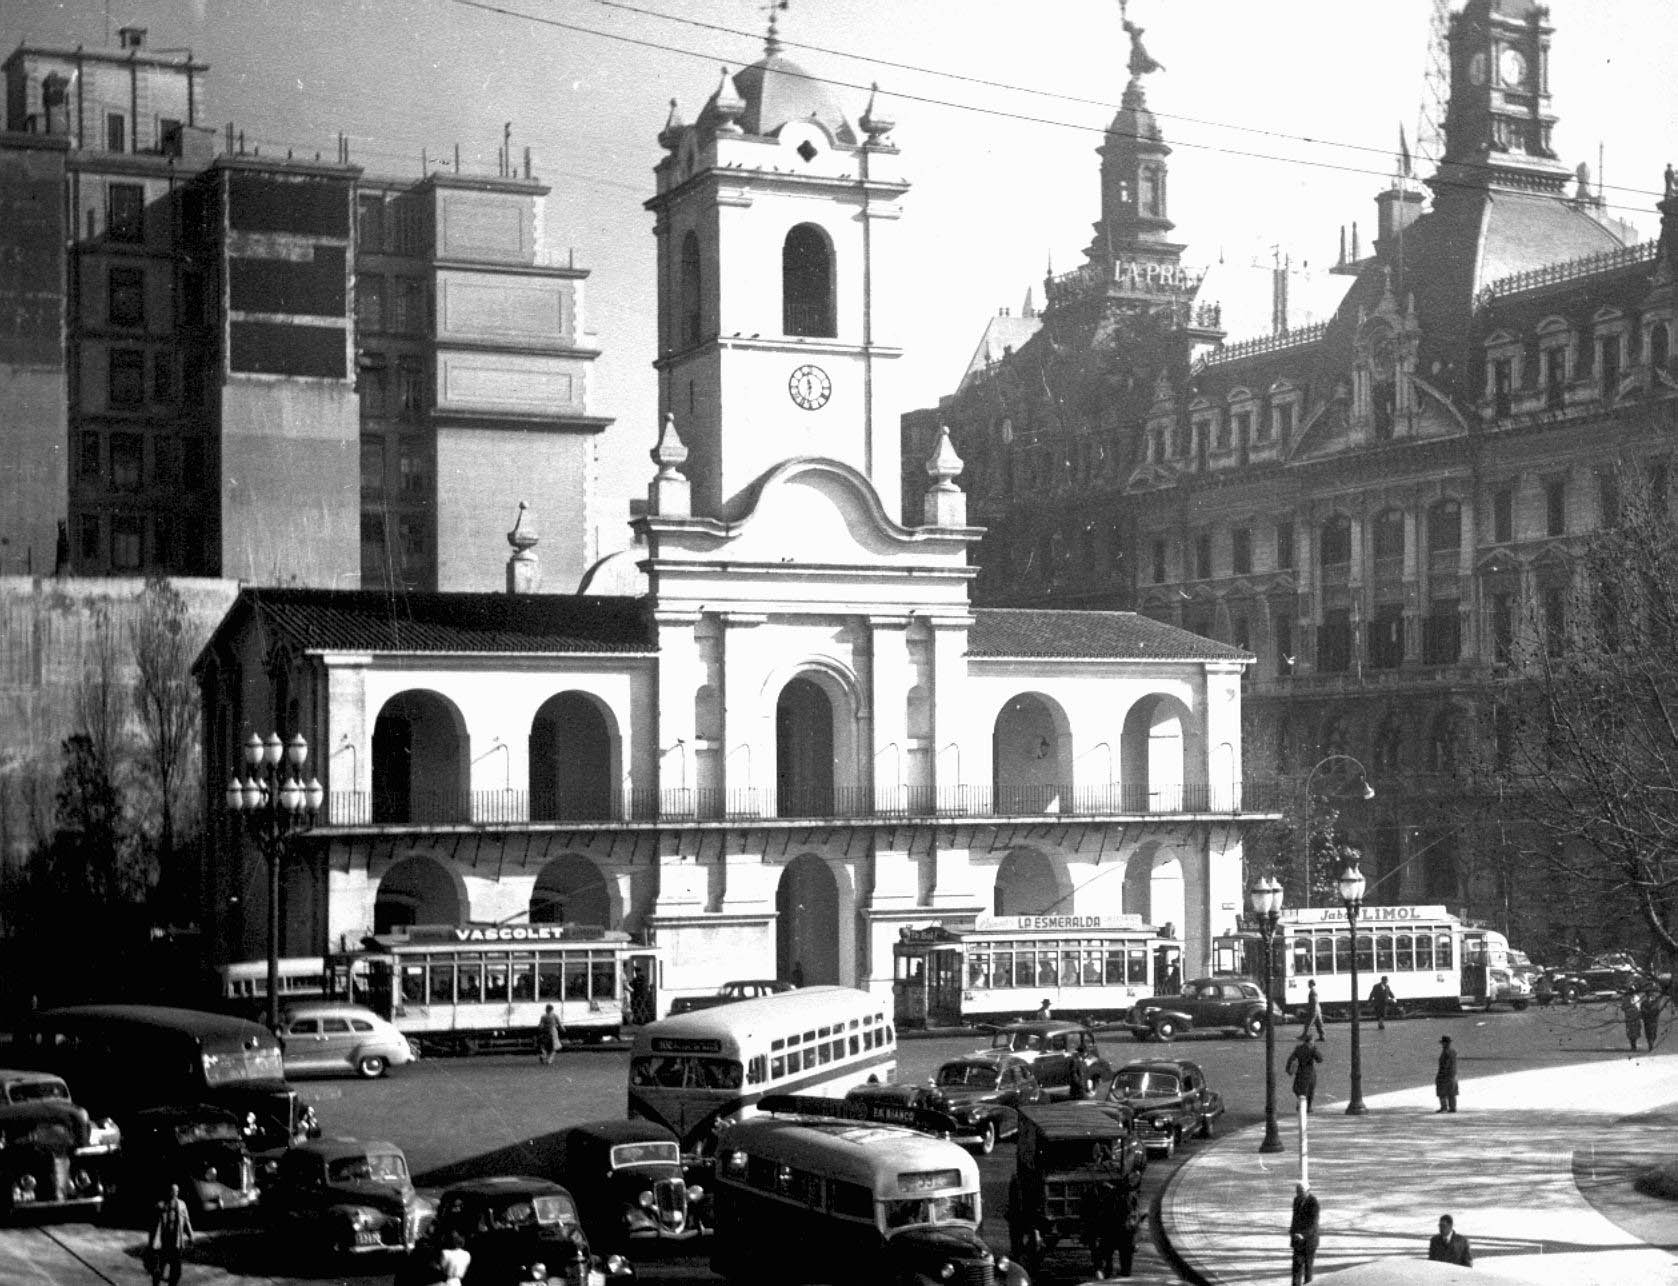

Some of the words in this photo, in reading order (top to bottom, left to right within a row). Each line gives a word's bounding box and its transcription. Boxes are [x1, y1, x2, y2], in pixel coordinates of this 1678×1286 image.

[1362, 907, 1421, 920] LIMOL
[1018, 916, 1031, 928] LA
[1034, 915, 1100, 928] ESMERALDA
[455, 926, 564, 941] VASCOLET
